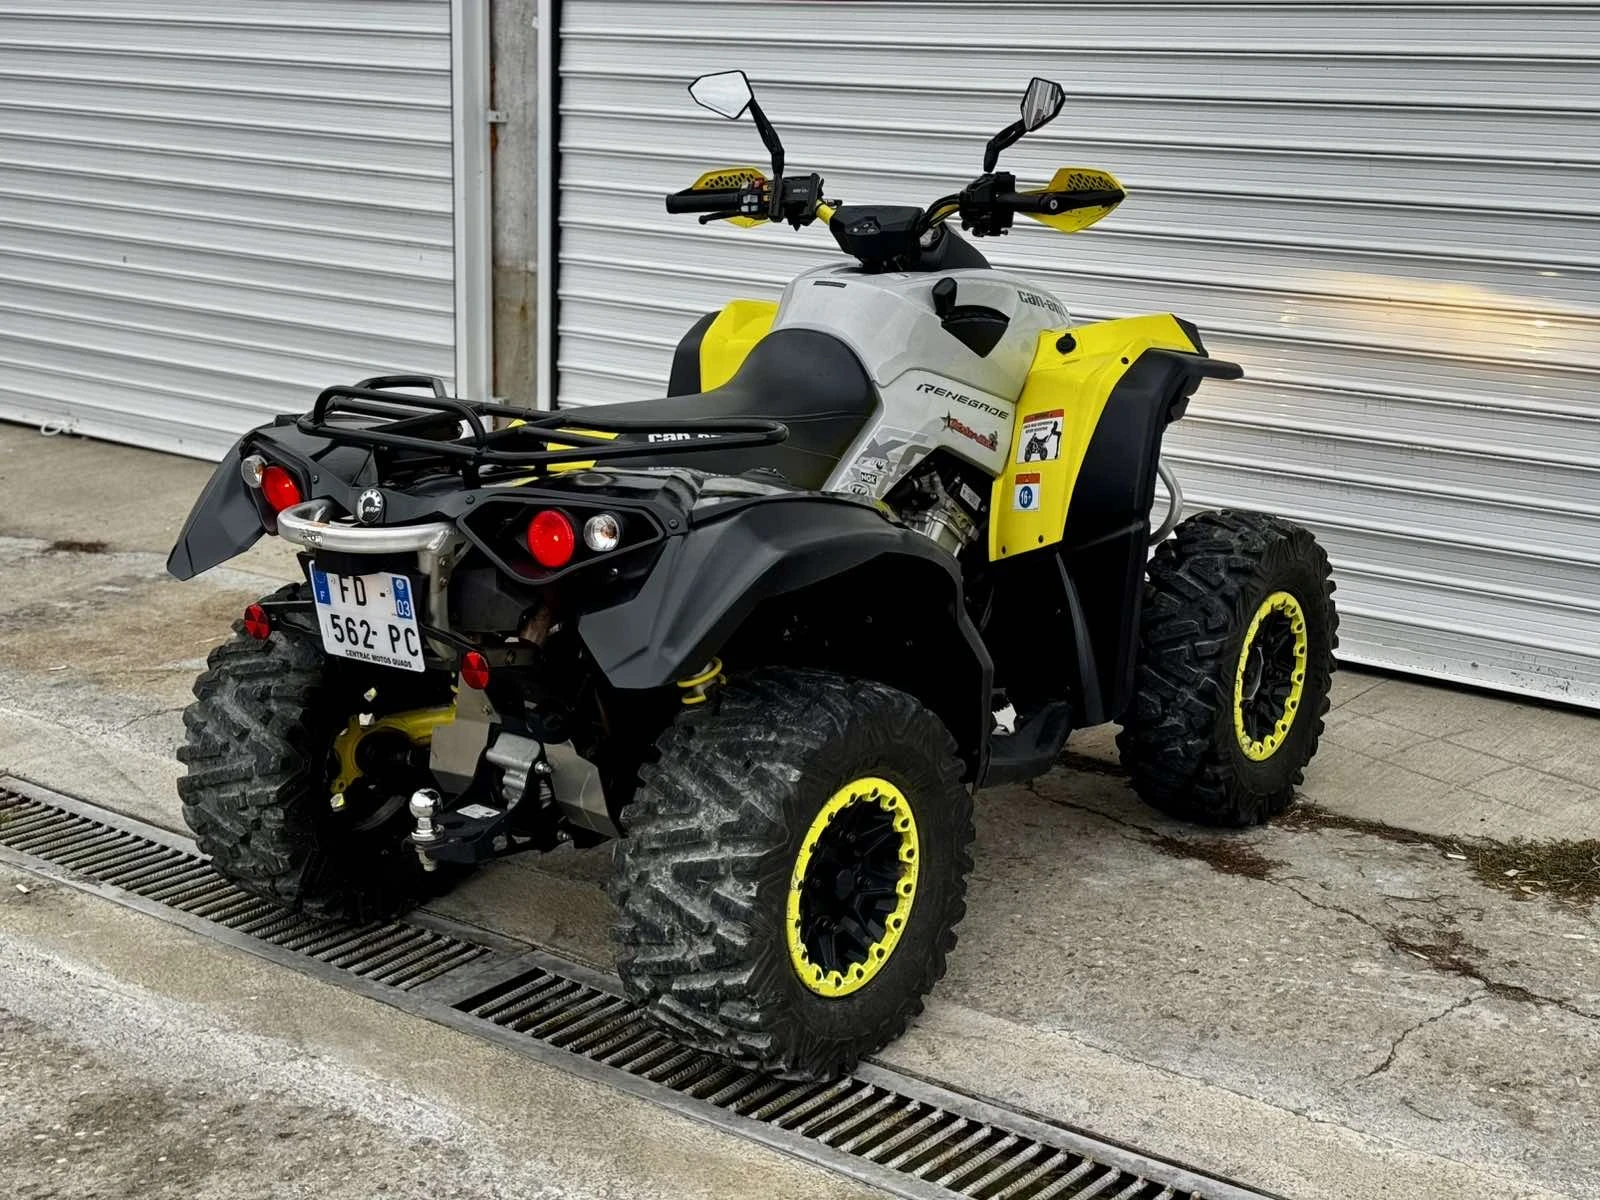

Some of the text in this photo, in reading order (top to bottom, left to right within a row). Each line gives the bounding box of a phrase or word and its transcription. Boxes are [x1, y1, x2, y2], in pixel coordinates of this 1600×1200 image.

[916, 383, 1009, 420] RENEGADE
[861, 472, 877, 485] NGK
[319, 591, 325, 600] F
[338, 575, 367, 606] FD
[396, 599, 411, 617] 03
[387, 624, 419, 657] PC
[371, 654, 392, 664] MOTOS
[392, 658, 413, 668] QUADS
